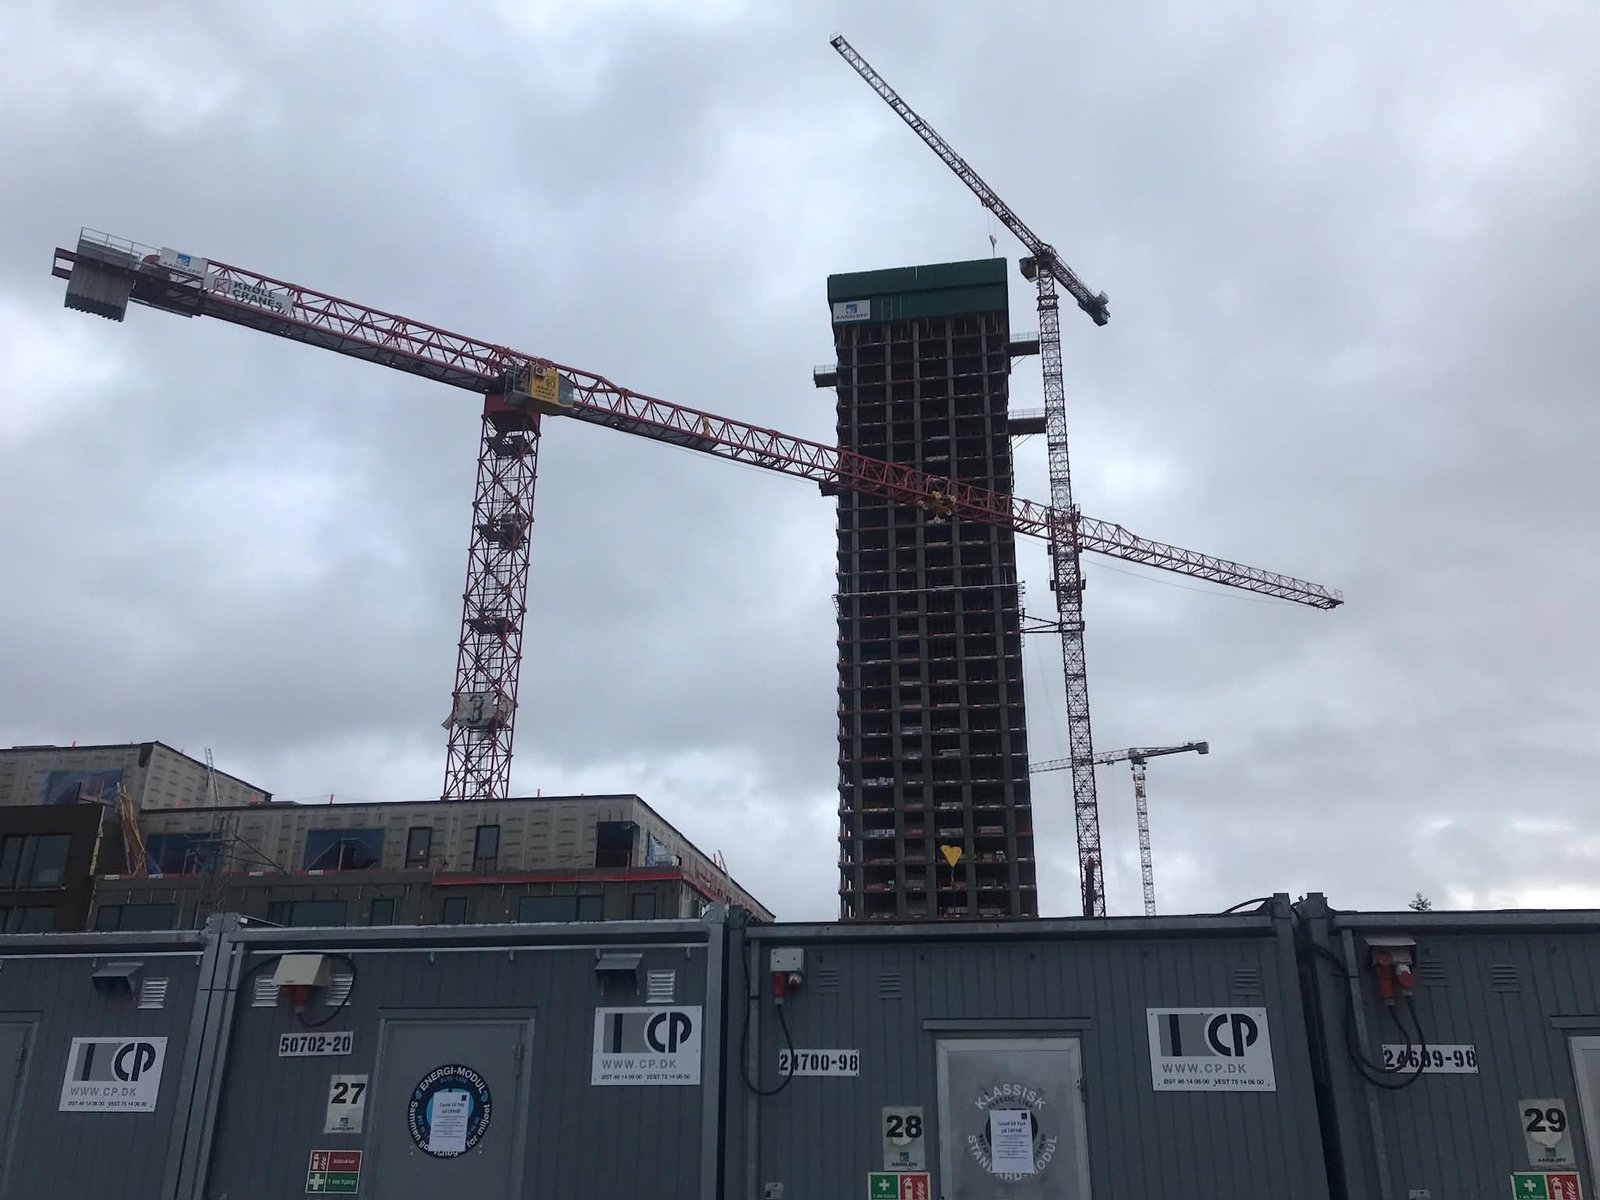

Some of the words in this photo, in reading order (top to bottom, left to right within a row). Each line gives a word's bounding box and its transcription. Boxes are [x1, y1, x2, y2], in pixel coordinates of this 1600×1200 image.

[232, 289, 283, 310] CRANES
[233, 281, 275, 299] KRØLL
[280, 1036, 350, 1052] 50702-20
[647, 1012, 693, 1053] CP
[1208, 1013, 1258, 1056] CP
[114, 1043, 156, 1081] CP
[602, 1060, 677, 1069] WWW.CP.DK
[1162, 1064, 1247, 1073] WWW.CP.DK
[420, 1067, 486, 1093] ENERGI-MODUL
[70, 1087, 137, 1097] WWW.CP.DK
[331, 1082, 365, 1105] 27
[975, 1083, 1046, 1110] KLASSISK
[410, 1101, 421, 1141] Sammen
[886, 1115, 923, 1138] 28
[1524, 1108, 1566, 1132] 29
